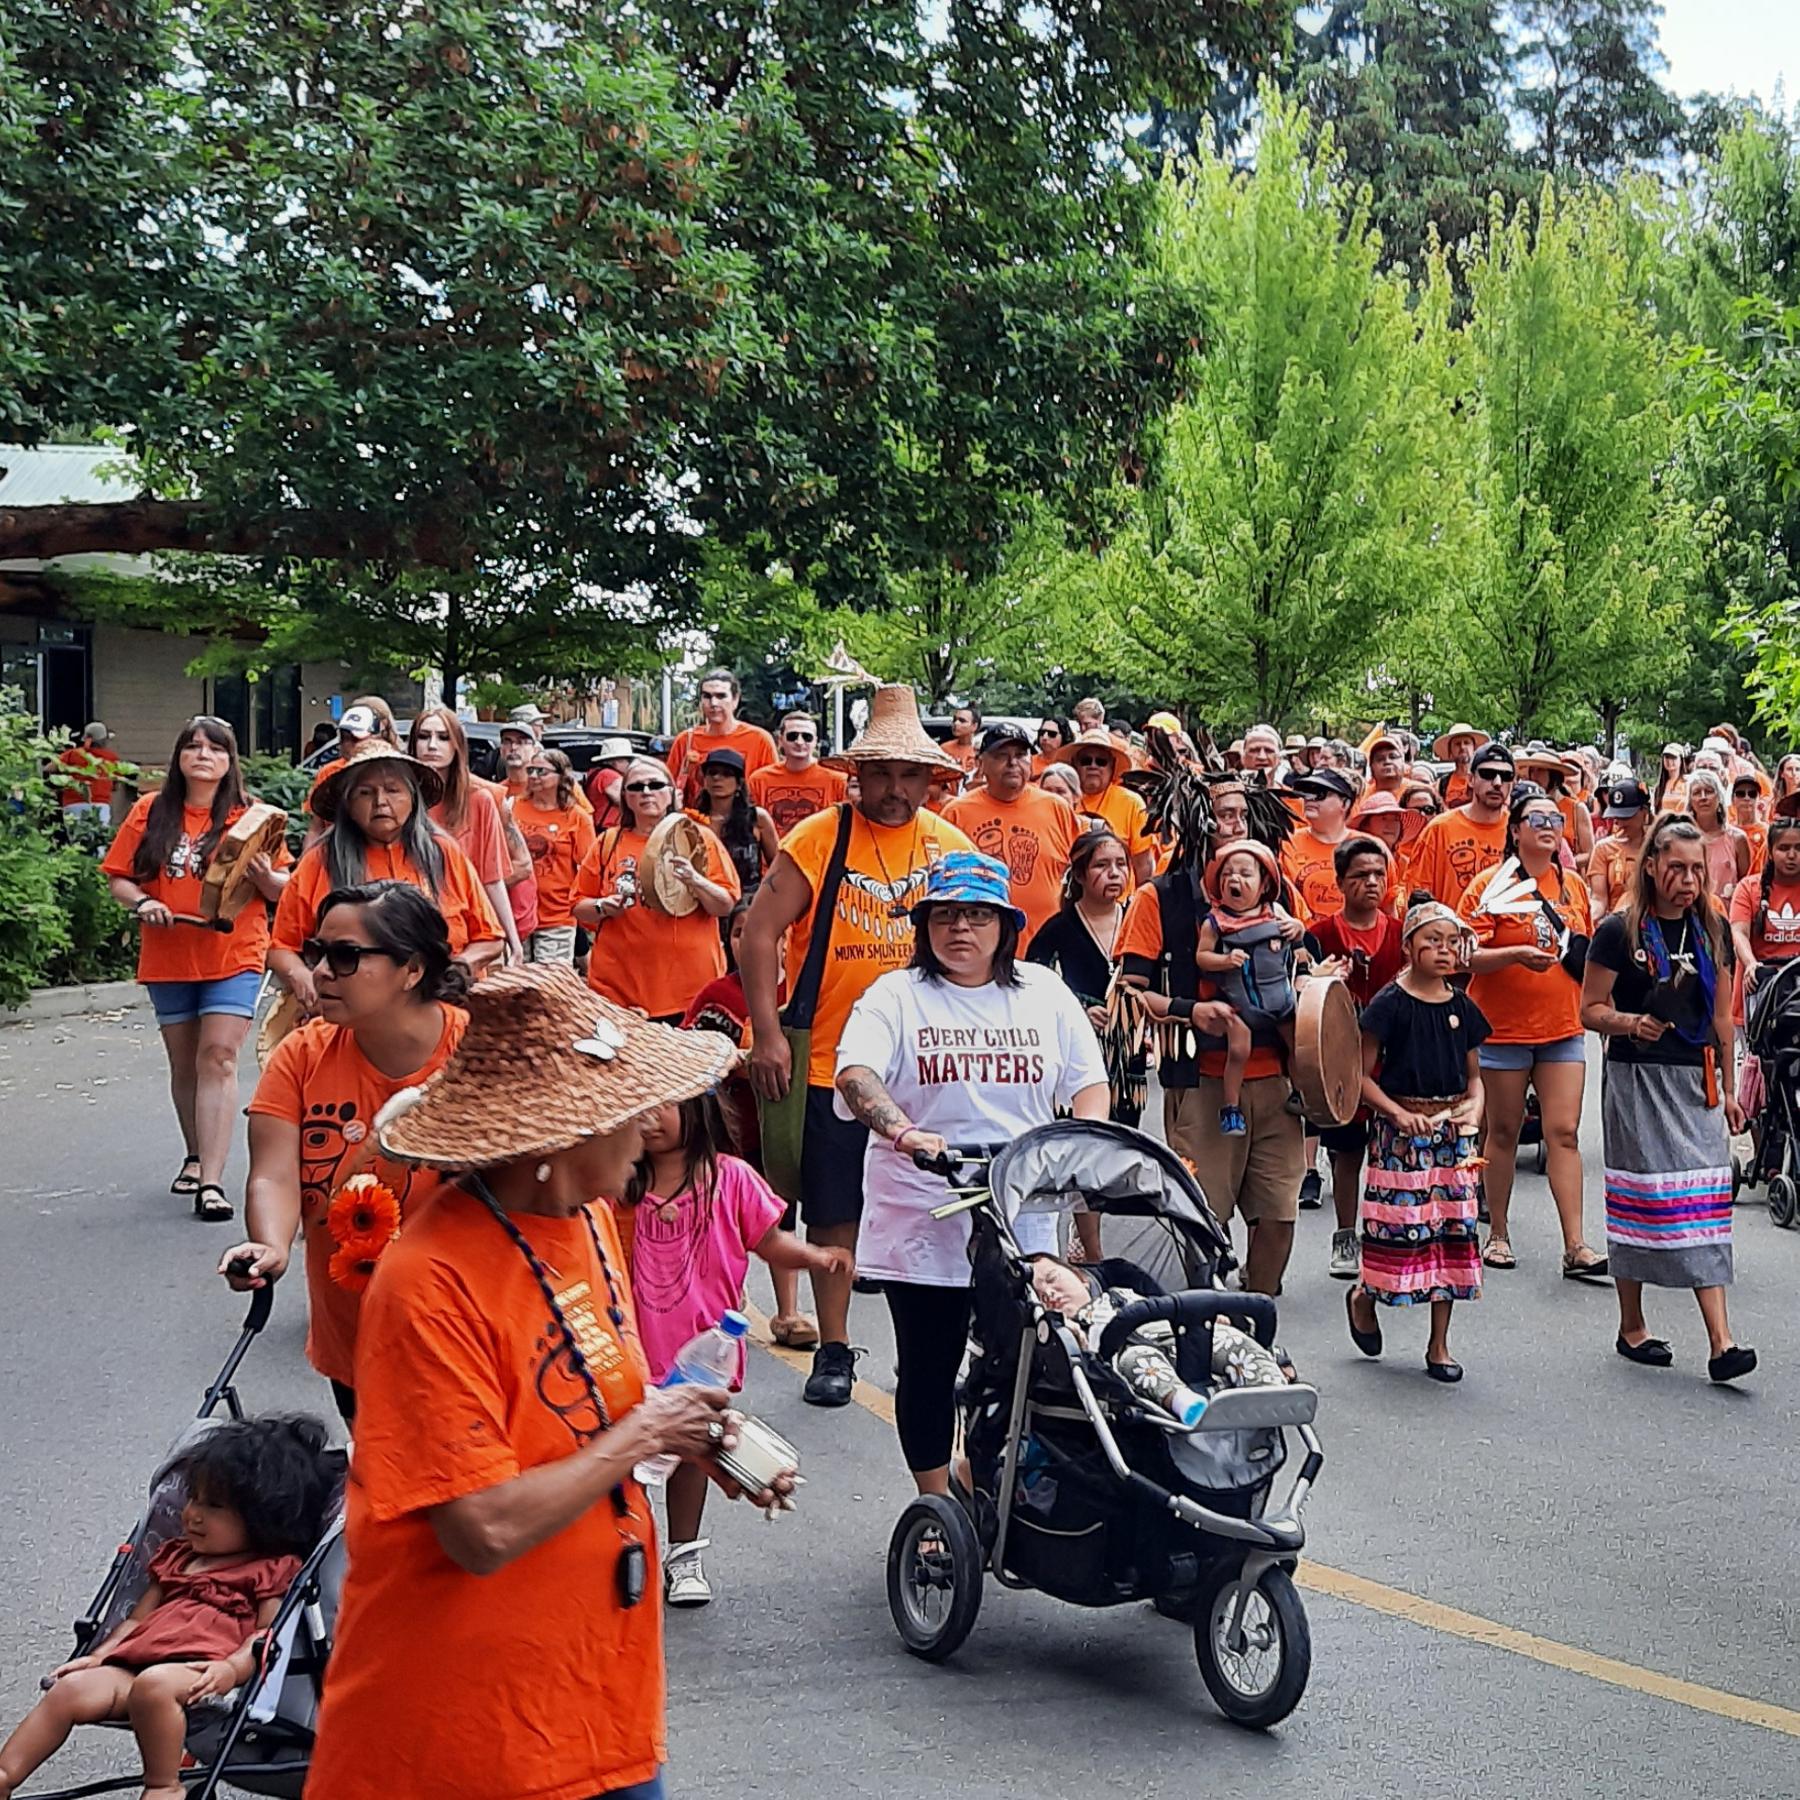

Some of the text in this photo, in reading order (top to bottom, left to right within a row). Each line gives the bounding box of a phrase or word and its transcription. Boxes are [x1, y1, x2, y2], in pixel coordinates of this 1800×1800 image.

[917, 1026, 1040, 1049] EVERY CHILD
[917, 1052, 1044, 1085] MATTERS
